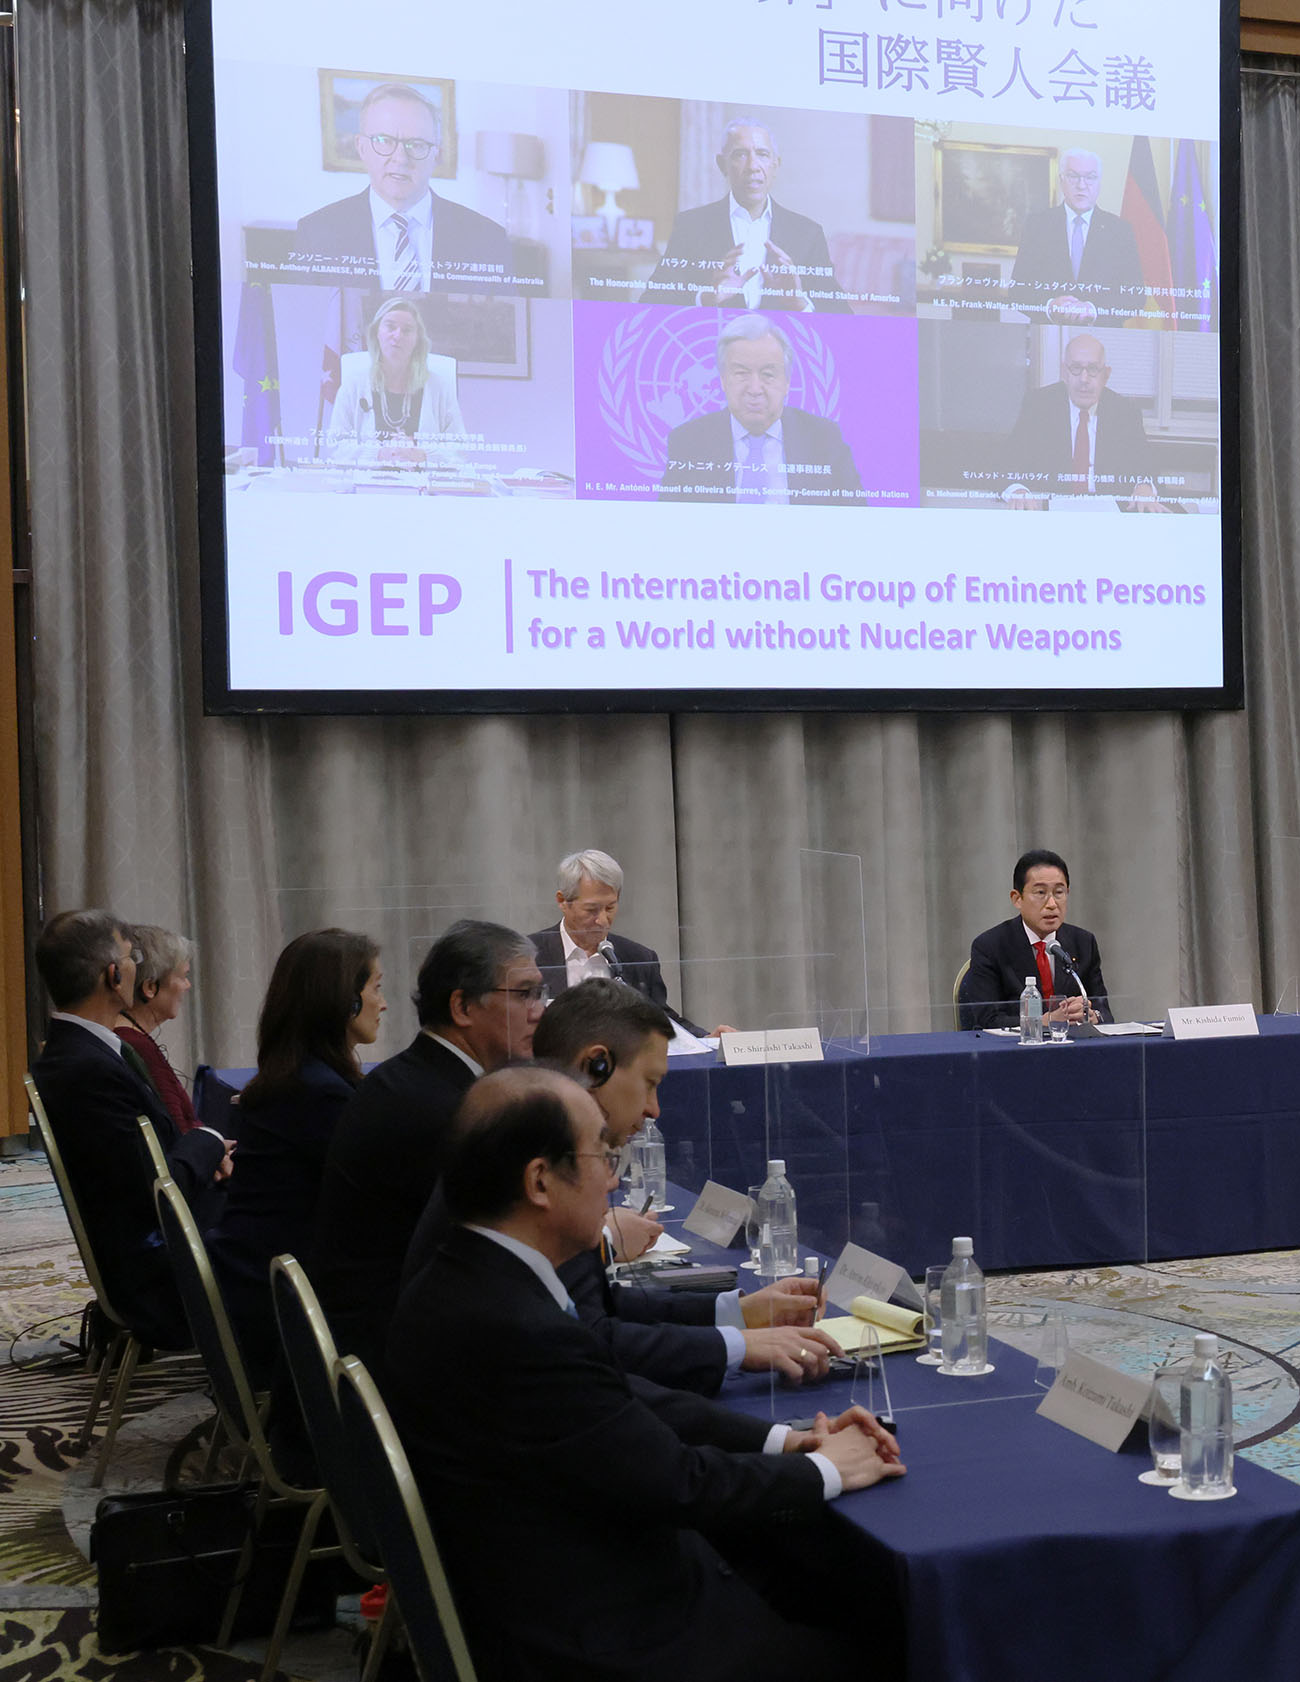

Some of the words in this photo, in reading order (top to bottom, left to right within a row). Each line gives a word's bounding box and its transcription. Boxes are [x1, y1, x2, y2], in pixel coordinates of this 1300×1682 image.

[818, 27, 1156, 111] 国際賢人会議
[245, 261, 259, 269] The
[260, 262, 278, 270] Hon.
[280, 263, 310, 273] Anthony
[312, 265, 353, 275] ALBANESE,
[661, 257, 725, 270] バラク・オバマ
[433, 272, 445, 280] the
[446, 272, 501, 283] Commonwealth
[503, 275, 511, 283] of
[512, 276, 544, 286] Australia
[589, 277, 604, 287] The
[606, 278, 647, 290] Honorable
[648, 280, 676, 291] Barack
[678, 282, 686, 291] H.
[688, 282, 717, 294] Obama,
[786, 290, 794, 298] of
[795, 290, 808, 298] the
[809, 290, 834, 300] United
[835, 292, 859, 301] States
[860, 293, 869, 301] of
[870, 294, 900, 303] America
[932, 298, 948, 307] H.E.
[949, 299, 960, 308] Dr.
[961, 300, 1009, 311] Frank-Walter
[1098, 307, 1110, 316] the
[1111, 308, 1137, 317] Federal
[1139, 309, 1169, 319] Republic
[1171, 310, 1179, 319] of
[1180, 311, 1211, 321] Germany
[668, 461, 769, 473] アントニオ・グテーレス
[777, 463, 832, 475] 国連事務総長
[585, 482, 594, 491] H.
[596, 483, 604, 491] E.
[605, 483, 617, 491] Mr.
[619, 483, 650, 492] António
[652, 484, 681, 493] Manuel
[683, 484, 693, 493] de
[694, 485, 724, 494] Oliveira
[726, 486, 760, 497] Guterres,
[762, 487, 831, 498] Secretary-General
[832, 489, 841, 497] of
[841, 489, 854, 497] the
[855, 489, 879, 499] United
[881, 490, 910, 499] Nations
[926, 489, 936, 498] Dr.
[936, 490, 968, 499] Mohamed
[1157, 496, 1178, 505] Energy
[527, 568, 589, 600] The
[600, 571, 810, 601] International
[820, 573, 916, 608] Group
[925, 573, 957, 602] of
[965, 575, 1087, 604] Eminent
[1096, 577, 1206, 605] Persons
[277, 571, 462, 637] IGEP
[528, 617, 578, 649] for
[586, 626, 606, 650] a
[616, 619, 714, 650] World
[725, 619, 850, 651] without
[860, 621, 978, 652] Nuclear
[985, 623, 1122, 657] Weapons
[1181, 1017, 1193, 1025] Mr.
[1195, 1015, 1222, 1024] Kishida
[733, 1046, 746, 1054] Dr.
[747, 1043, 781, 1053] Shiraishi
[782, 1042, 813, 1051] Takashi
